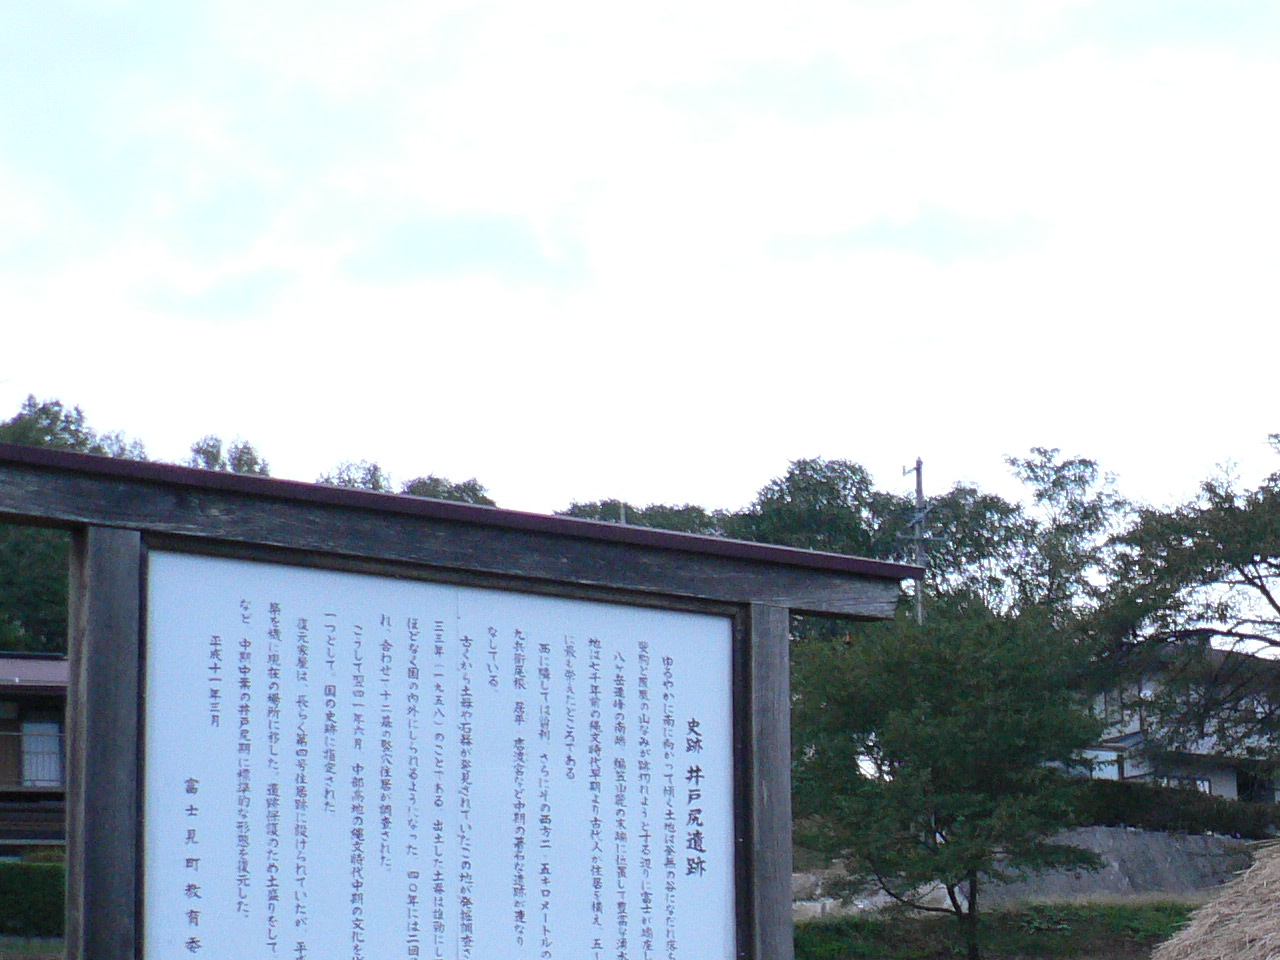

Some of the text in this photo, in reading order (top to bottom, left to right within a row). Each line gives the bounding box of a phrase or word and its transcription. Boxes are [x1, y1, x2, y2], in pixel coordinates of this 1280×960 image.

[206, 633, 223, 728] 平成十一年三月
[683, 716, 707, 878] 史跡 井戸尻遺跡
